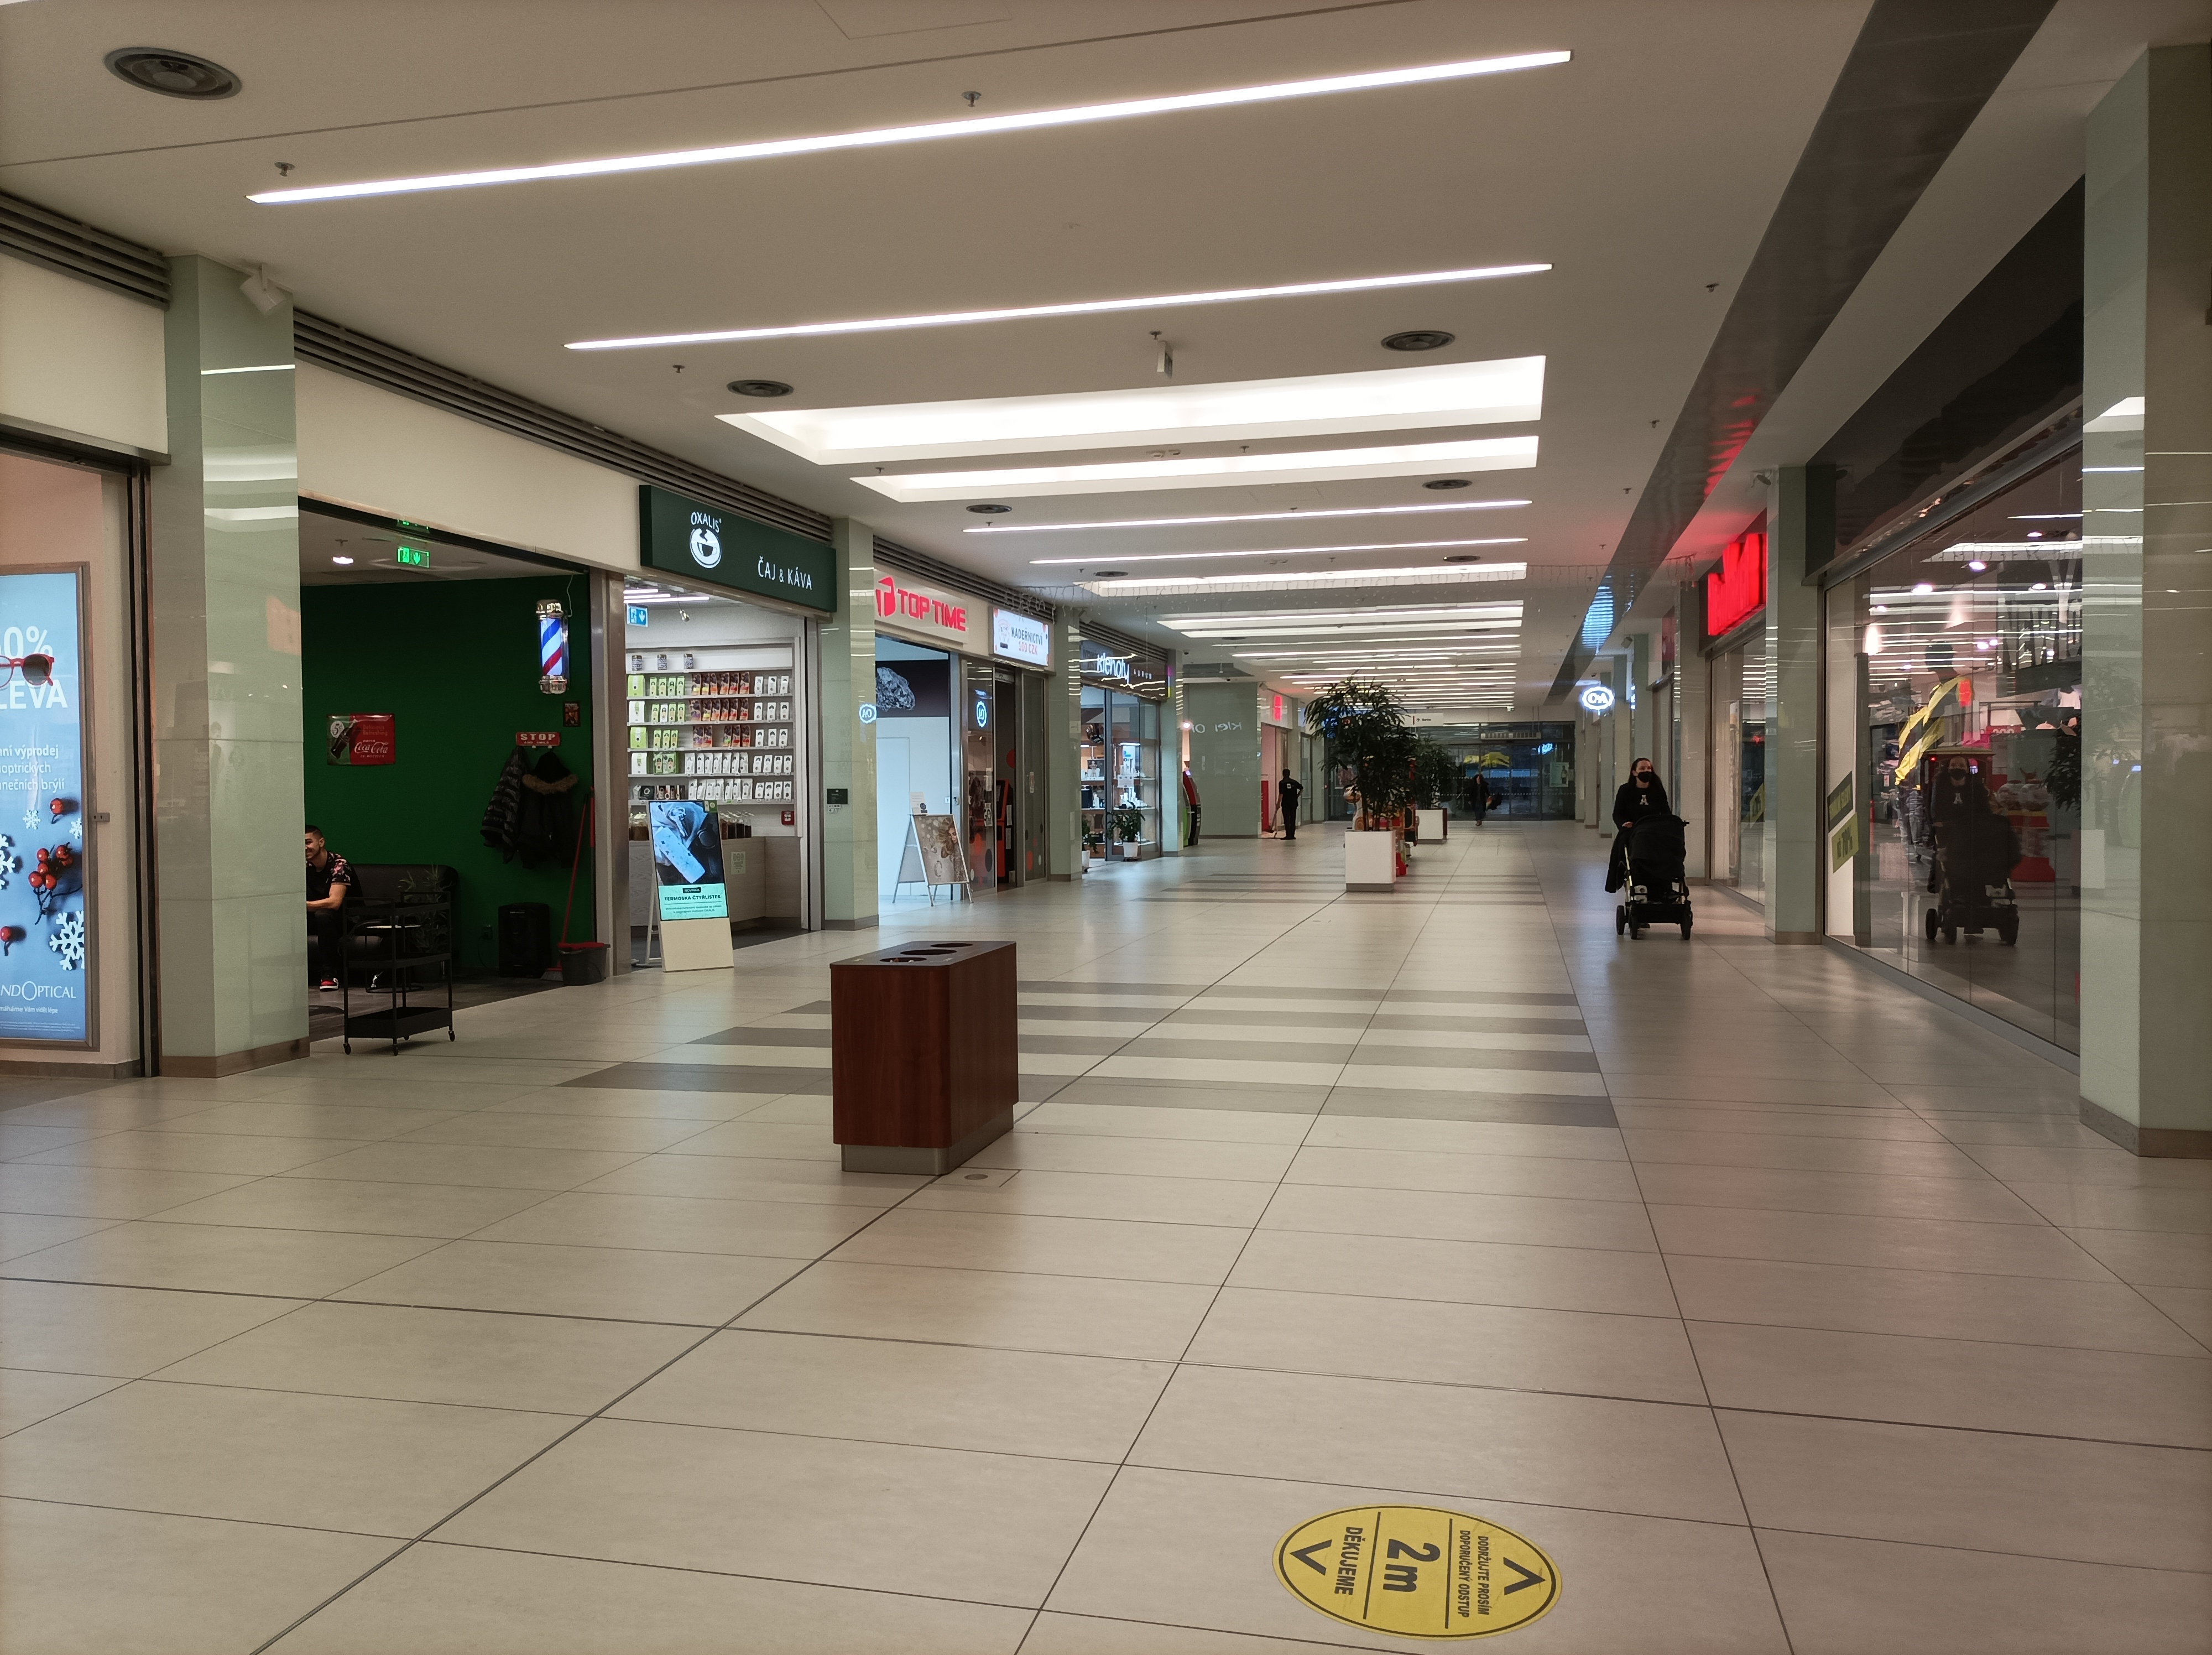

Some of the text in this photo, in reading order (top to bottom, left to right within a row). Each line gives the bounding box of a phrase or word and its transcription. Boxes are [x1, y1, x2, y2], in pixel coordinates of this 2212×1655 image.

[758, 555, 812, 590] ČAJ & KÁVA
[897, 589, 930, 620] TOP
[931, 600, 966, 632] TIME
[1011, 626, 1043, 646] KADEŘNICTVÍ
[1019, 641, 1038, 655] 100 CZK
[14, 744, 59, 760] výprodej
[0, 761, 51, 777] optrických
[41, 778, 65, 793] brýlí
[1639, 792, 1649, 805] A
[1334, 1526, 1366, 1595] DĚKUJEME
[1383, 1538, 1441, 1592] 2 m
[1458, 1530, 1473, 1618] DOPORUČENÝ ODSTUP
[1477, 1536, 1493, 1615] DODRŽUJTE PROSÍM
